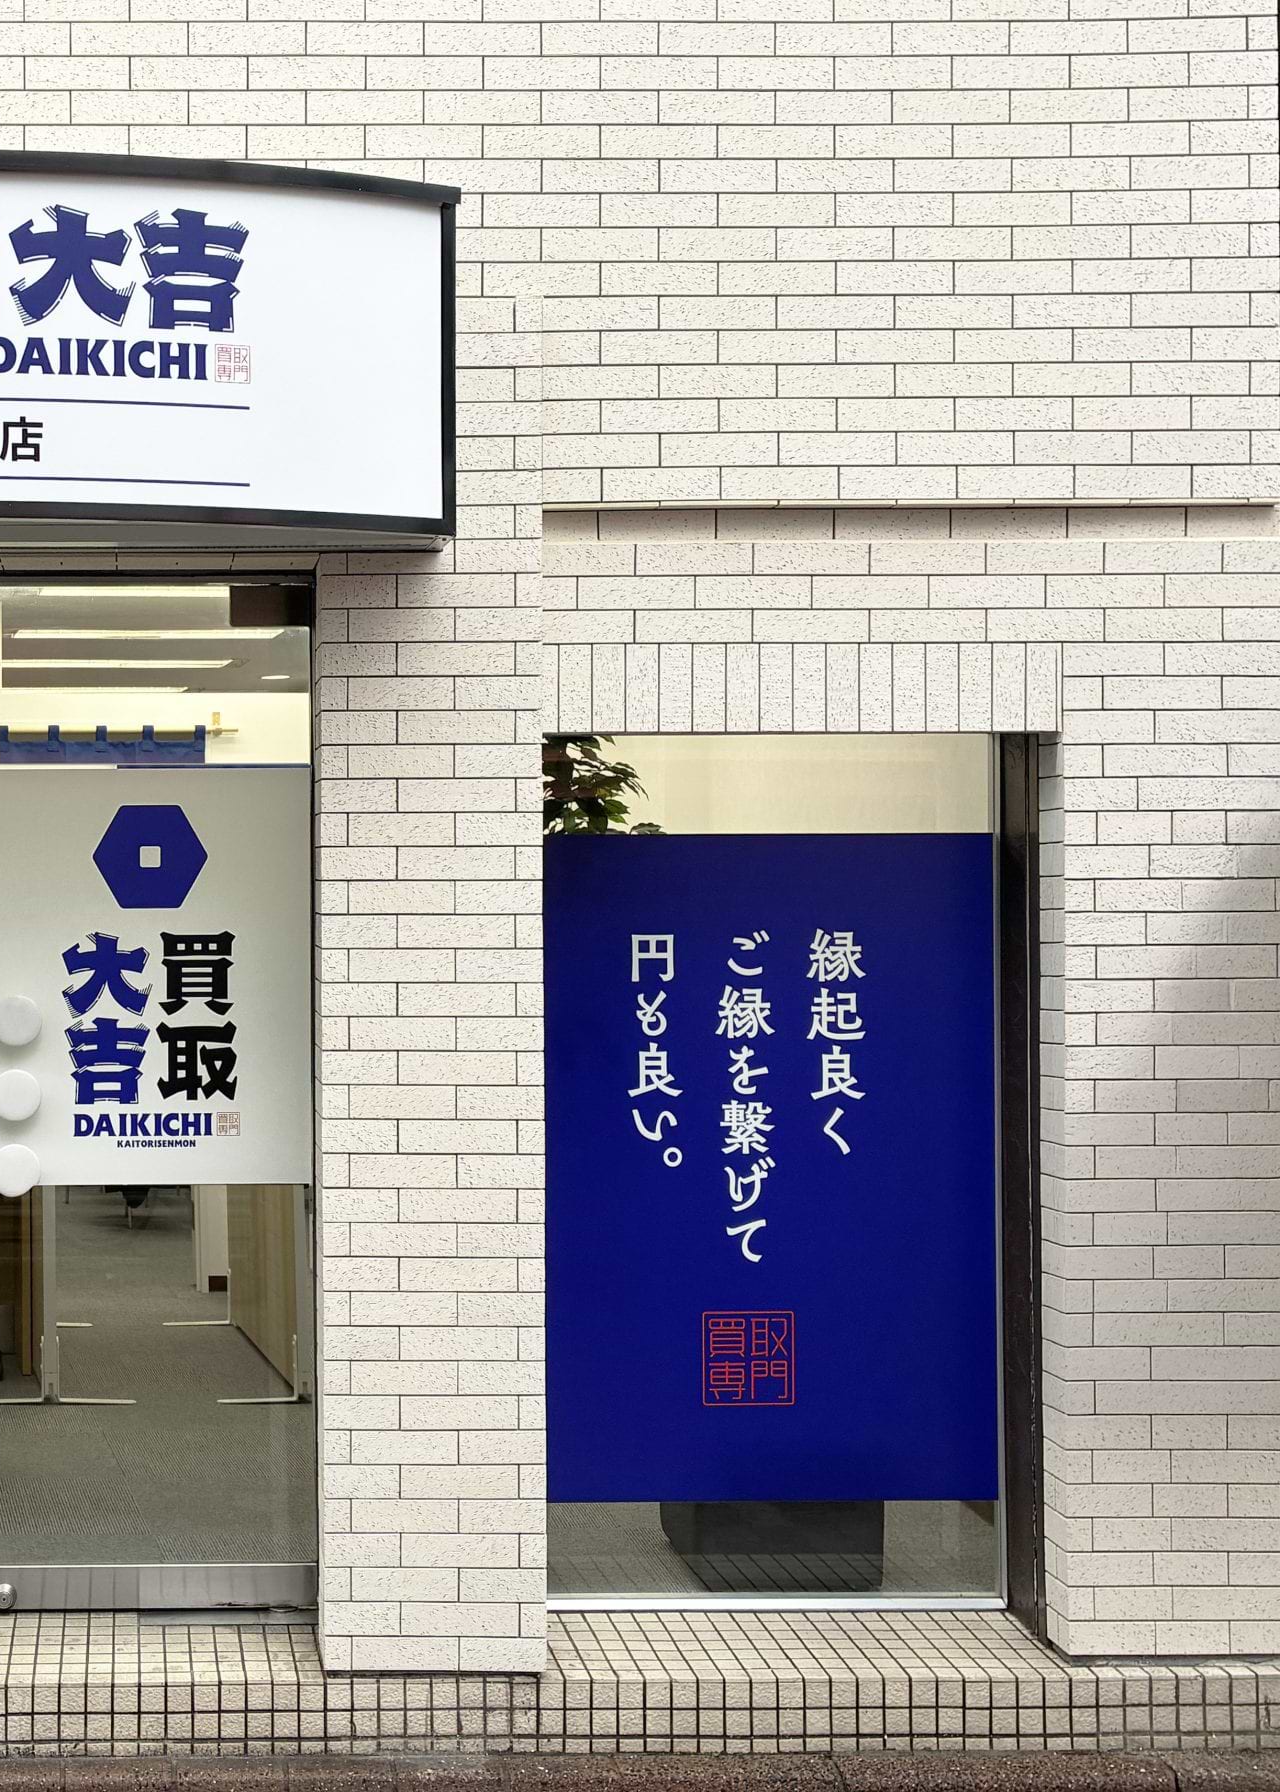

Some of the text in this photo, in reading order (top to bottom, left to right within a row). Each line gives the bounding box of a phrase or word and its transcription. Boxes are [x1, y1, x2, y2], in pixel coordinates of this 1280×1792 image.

[61, 931, 154, 1105] 大吉
[155, 930, 239, 1102] 買取
[627, 934, 683, 1168] 円も良い。
[715, 930, 776, 1263] ご縁を繋げて
[806, 928, 867, 1155] 縁起良く
[73, 1112, 214, 1138] DAIKICHI
[116, 1139, 197, 1148] KAITORISENMON
[708, 1318, 788, 1358] 買取
[708, 1360, 788, 1400] 専門
